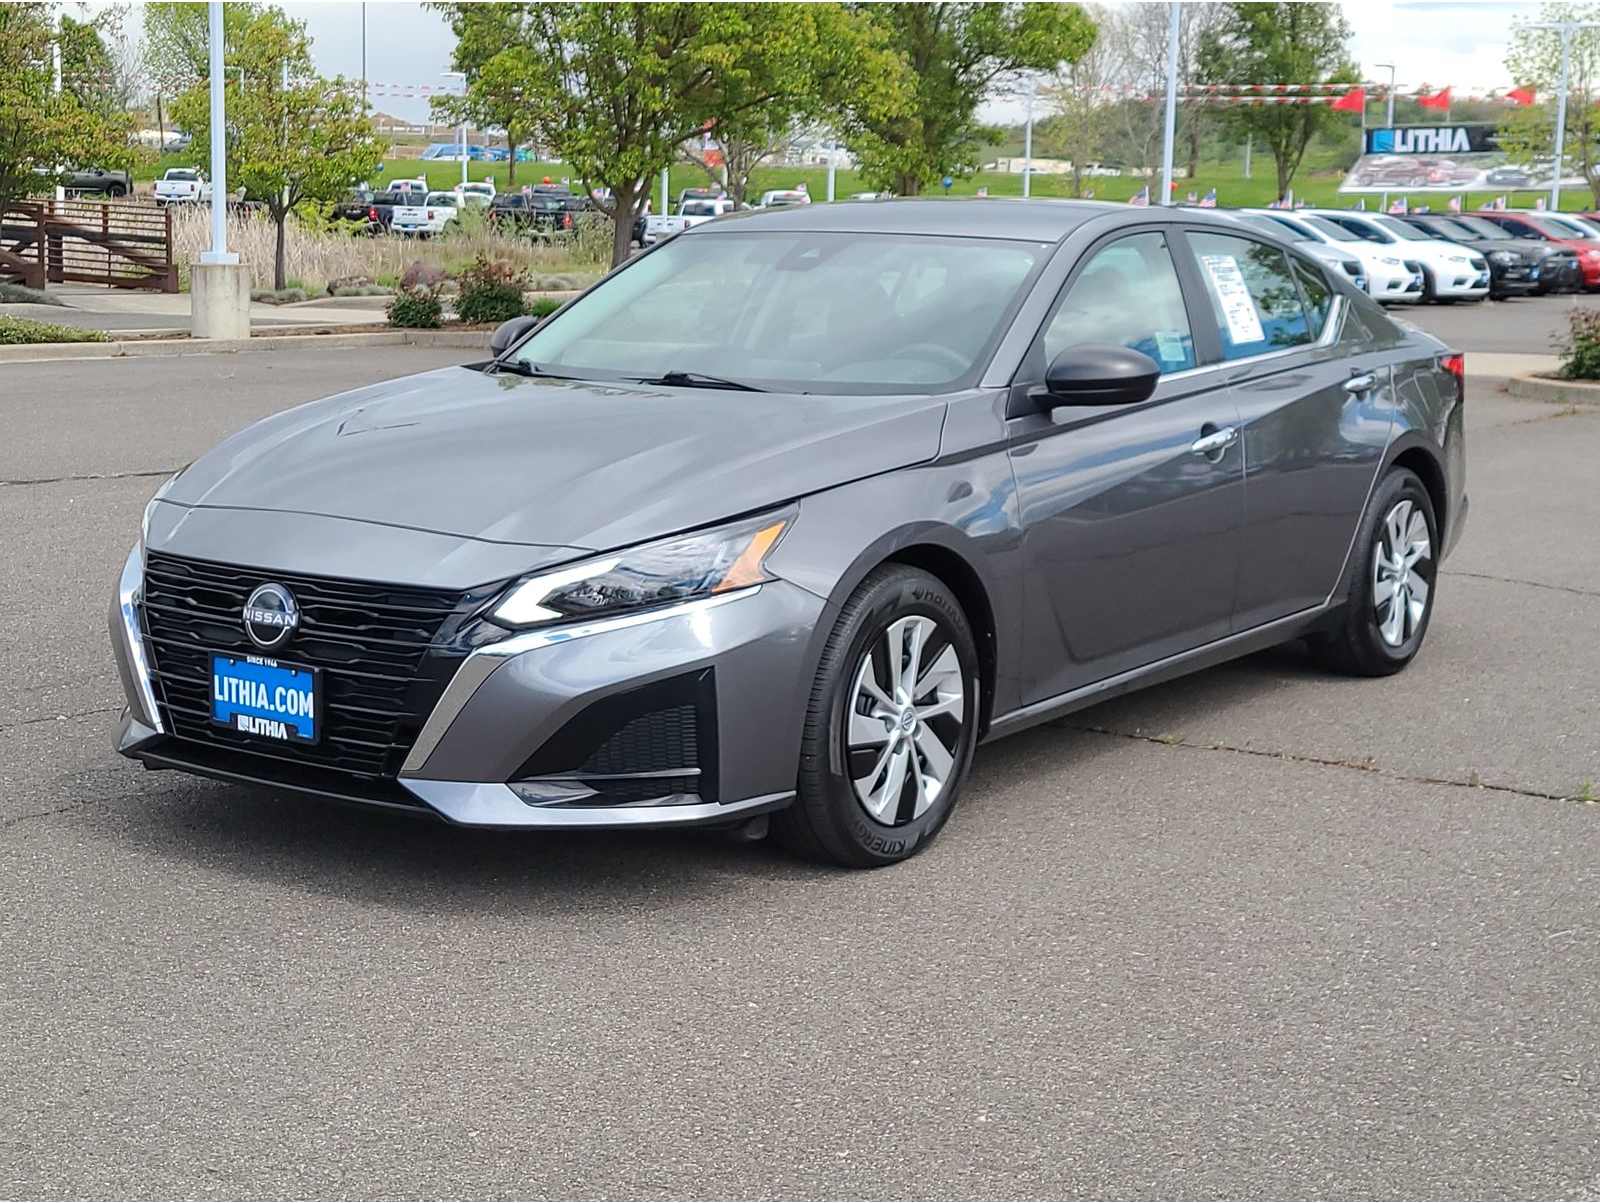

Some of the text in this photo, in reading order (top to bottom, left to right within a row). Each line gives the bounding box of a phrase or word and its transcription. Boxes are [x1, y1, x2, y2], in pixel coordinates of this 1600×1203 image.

[1394, 128, 1470, 153] LITHIA
[243, 608, 297, 626] NISSAN
[214, 674, 314, 719] LITHIA.COM
[249, 715, 288, 740] LITHIA
